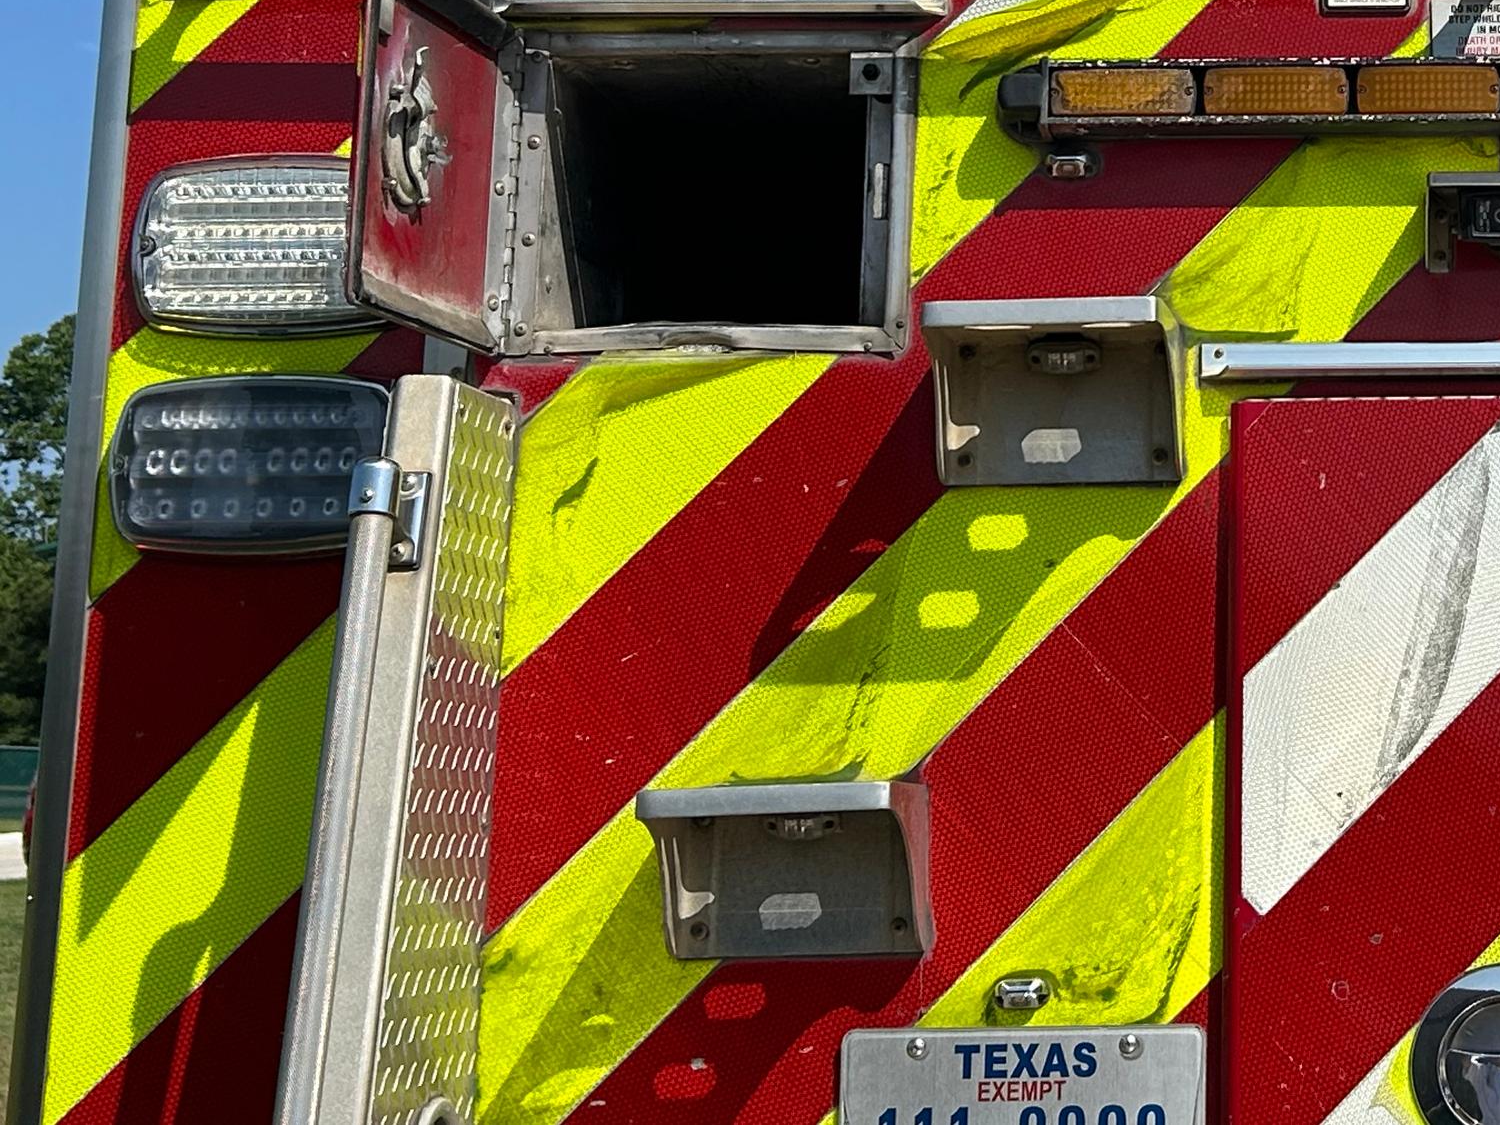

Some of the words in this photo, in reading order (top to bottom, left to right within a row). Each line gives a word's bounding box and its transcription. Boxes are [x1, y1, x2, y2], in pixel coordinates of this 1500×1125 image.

[1450, 4, 1464, 14] DO
[1466, 4, 1485, 13] NOT
[1448, 15, 1471, 24] STEP
[1477, 25, 1487, 34] IN
[1457, 36, 1487, 46] DEATH
[954, 1042, 1097, 1079] TEXAS
[976, 1079, 1067, 1102] EXEMPT
